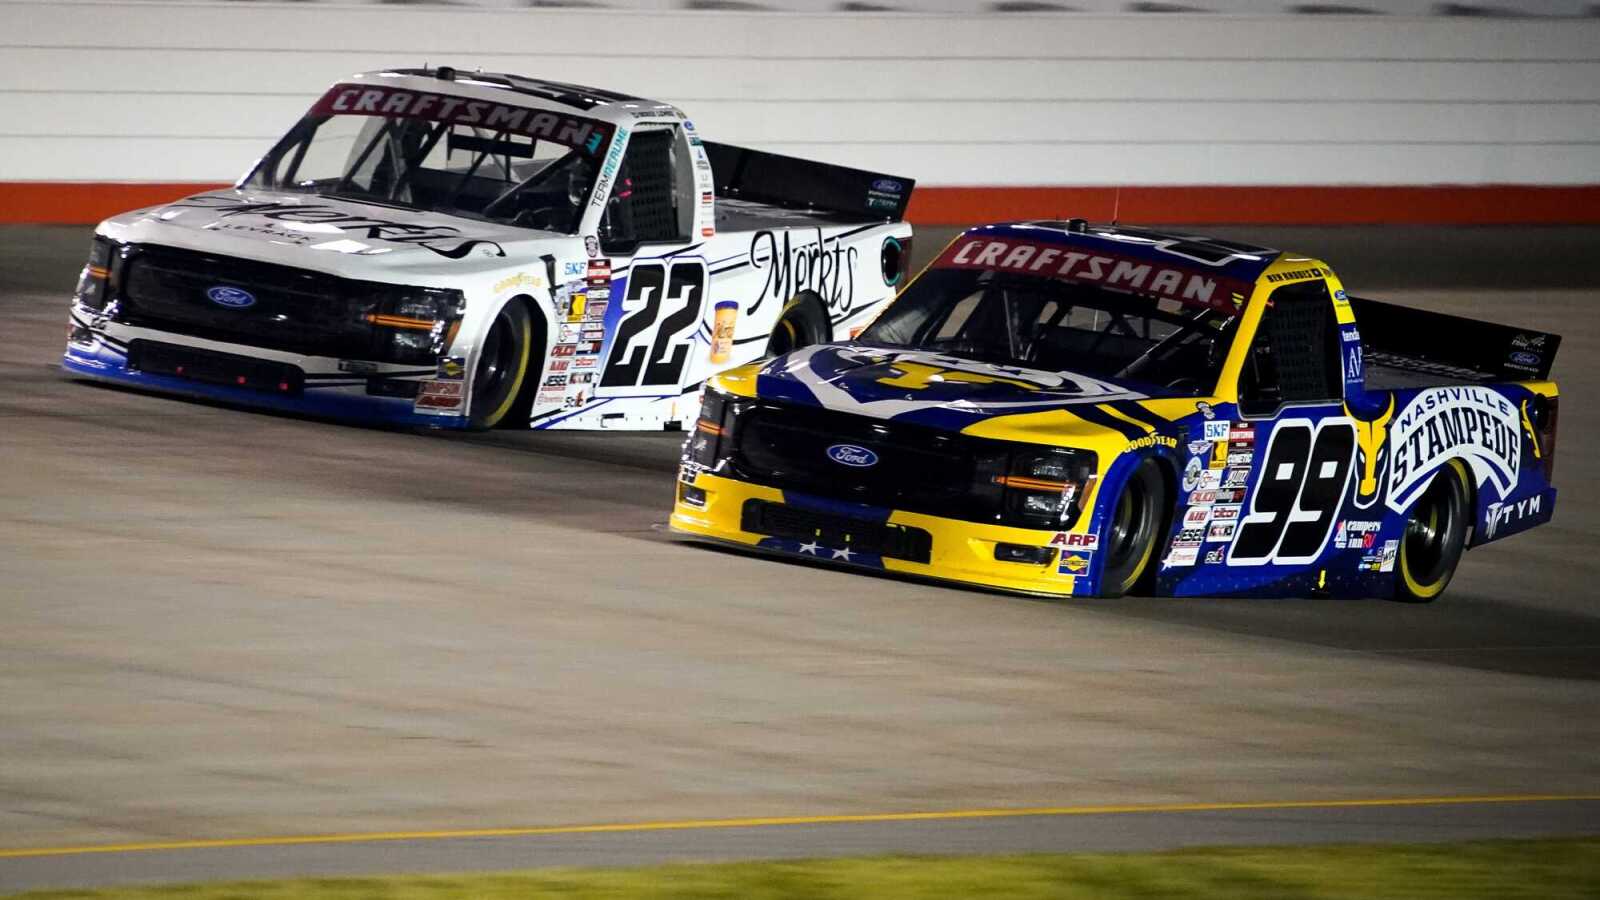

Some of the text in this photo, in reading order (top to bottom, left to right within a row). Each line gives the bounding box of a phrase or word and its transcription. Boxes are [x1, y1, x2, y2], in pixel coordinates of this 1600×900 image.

[331, 87, 592, 146] CRAFTSMAN
[565, 262, 586, 275] SKF
[952, 240, 1217, 303] CRAFTSMAN
[214, 288, 247, 305] Ford
[598, 262, 704, 388] 22
[1400, 388, 1510, 433] NASHVILLE
[1206, 424, 1228, 438] SKF
[836, 447, 869, 463] Ford
[1391, 406, 1518, 493] STAMPEDE
[1230, 424, 1355, 559] 99
[1503, 494, 1541, 524] TYM
[1050, 533, 1097, 546] ARP
[1347, 520, 1382, 536] campers
